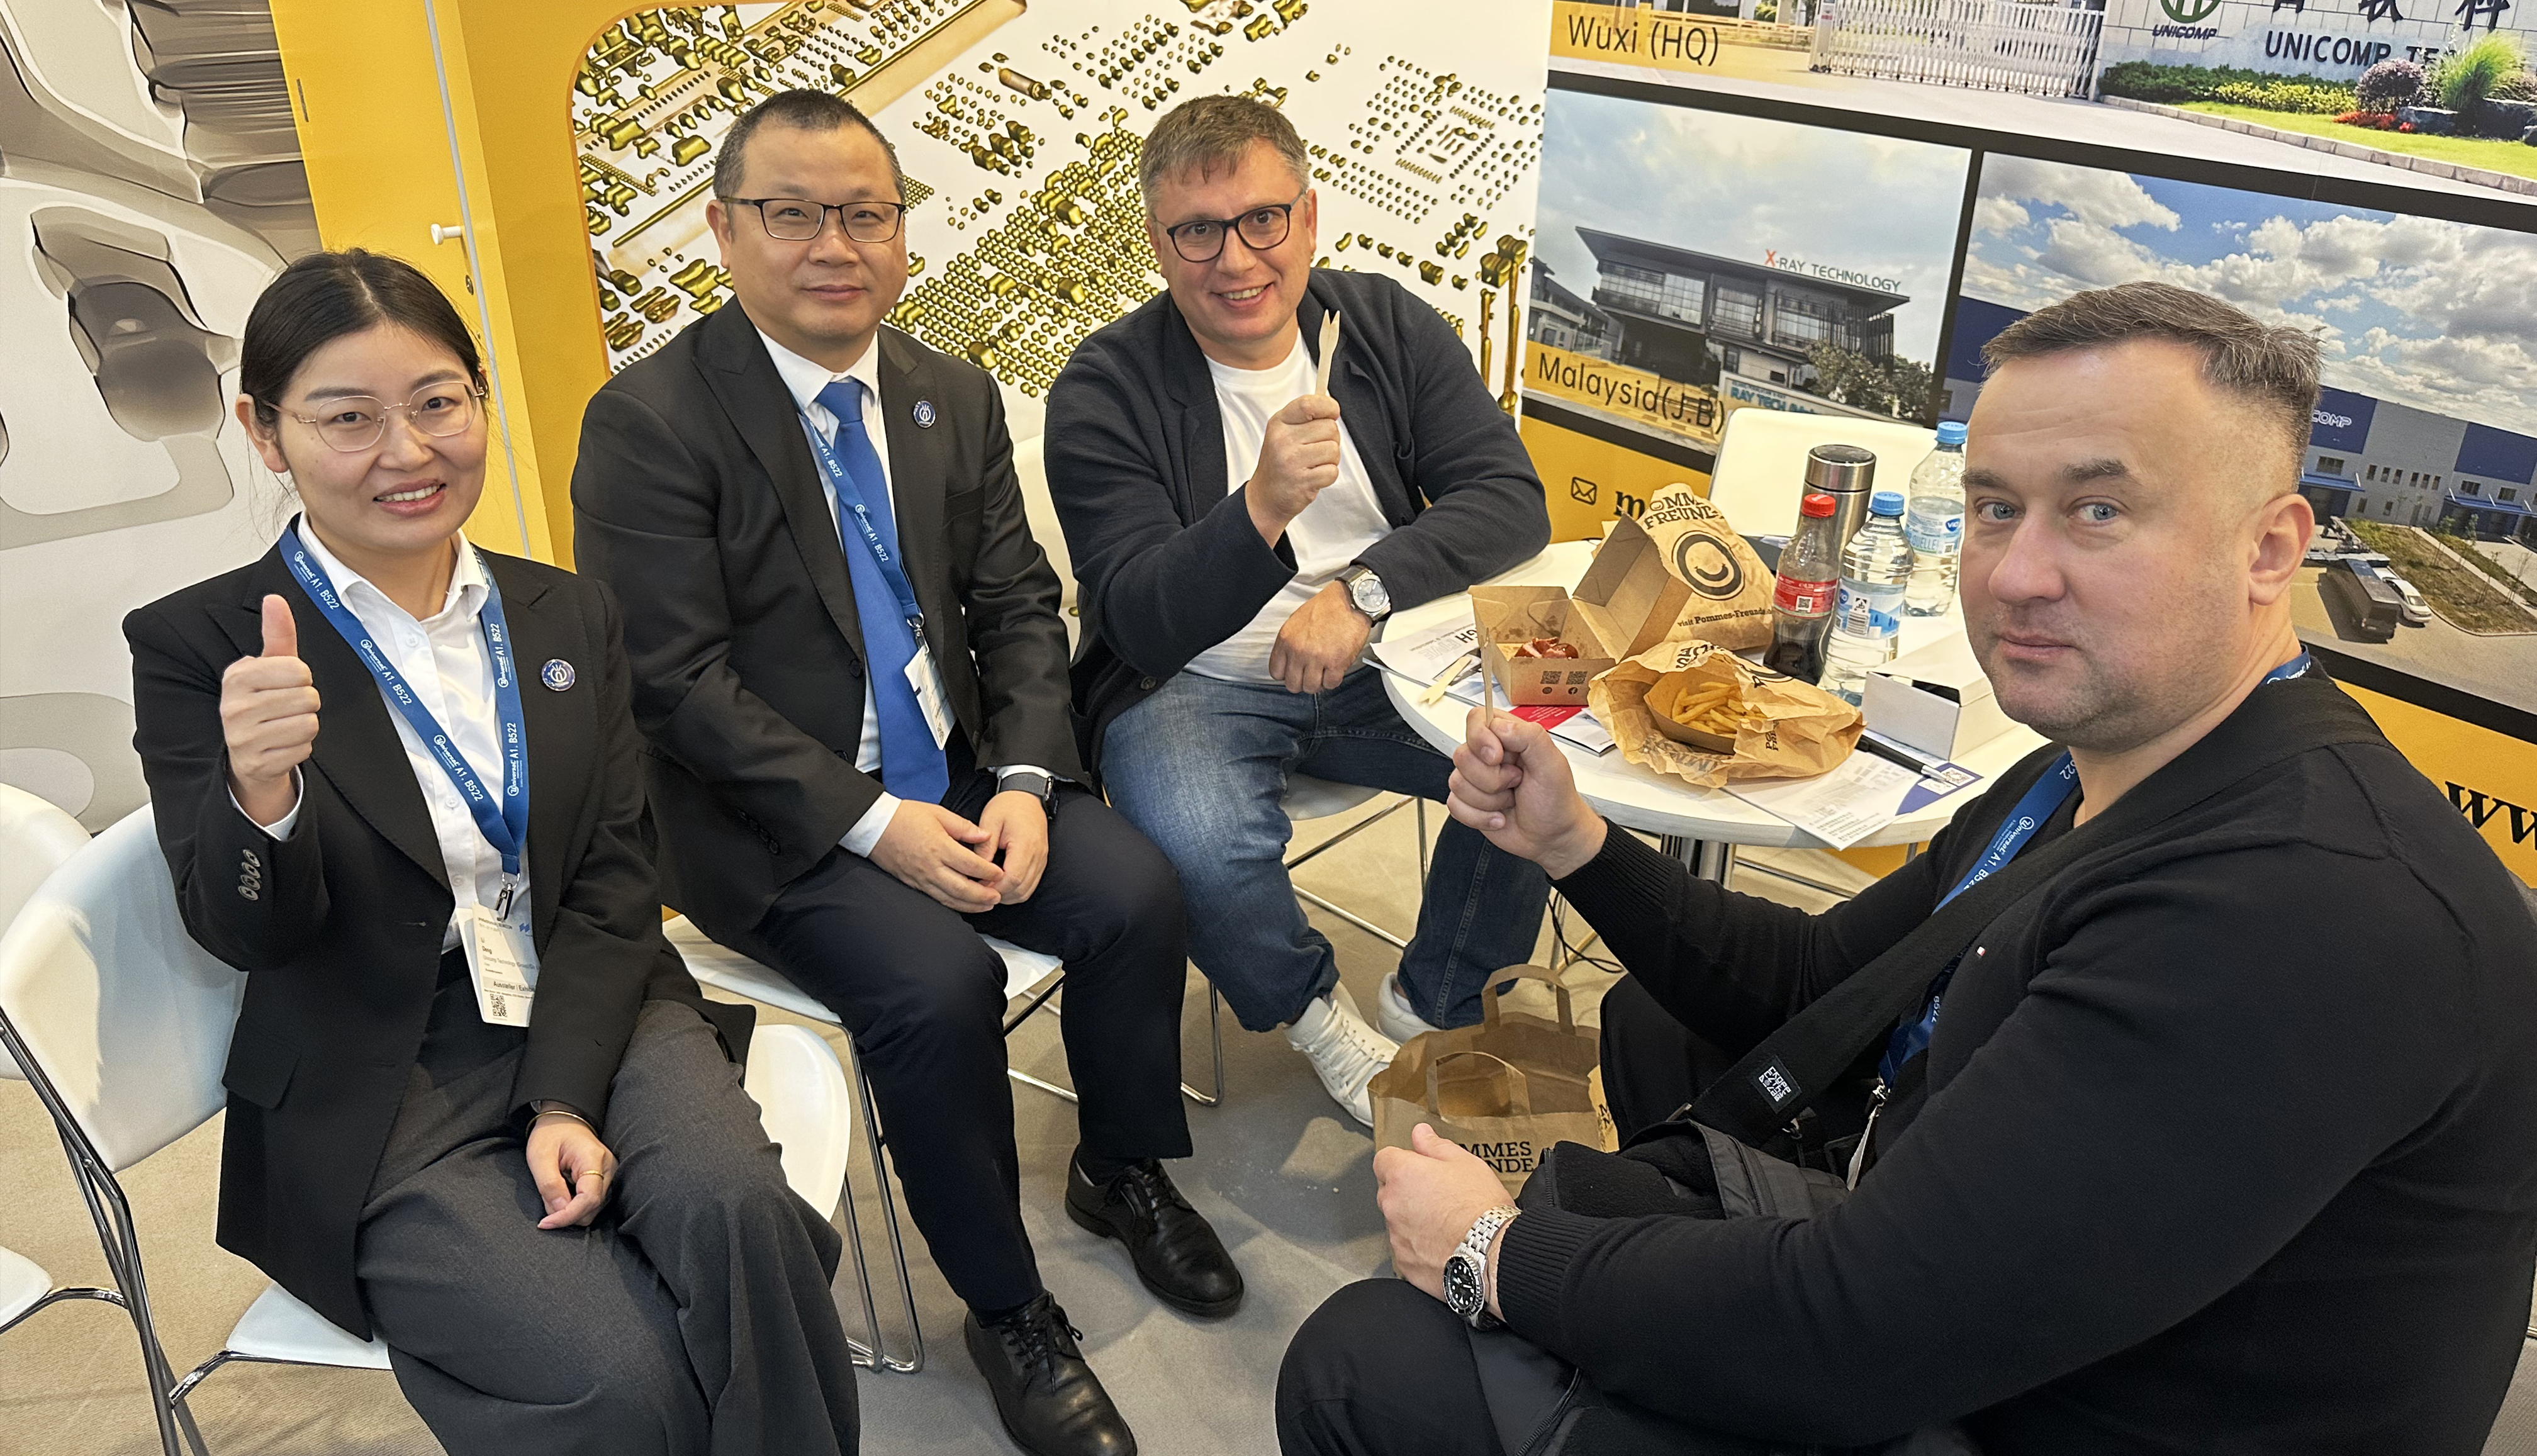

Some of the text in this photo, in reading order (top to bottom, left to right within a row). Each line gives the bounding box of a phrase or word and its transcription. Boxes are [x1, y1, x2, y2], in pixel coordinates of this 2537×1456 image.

[1568, 14, 1718, 67] Wuxi (HQ)
[2153, 25, 2217, 40] UNICOMP
[2266, 30, 2392, 67] UNICOMP
[1765, 249, 1901, 293] X-RAY TECHNOLOGY
[1730, 386, 1754, 403] RAY
[1757, 393, 1786, 412] TECH
[827, 459, 843, 478] B522
[874, 544, 889, 563] B522
[320, 589, 340, 610] B522
[490, 623, 502, 642] B522
[1677, 619, 1694, 627] visit
[392, 683, 413, 706] B522
[507, 722, 518, 744] B522
[464, 780, 484, 802] B522
[1769, 1066, 1791, 1093] CROPP
